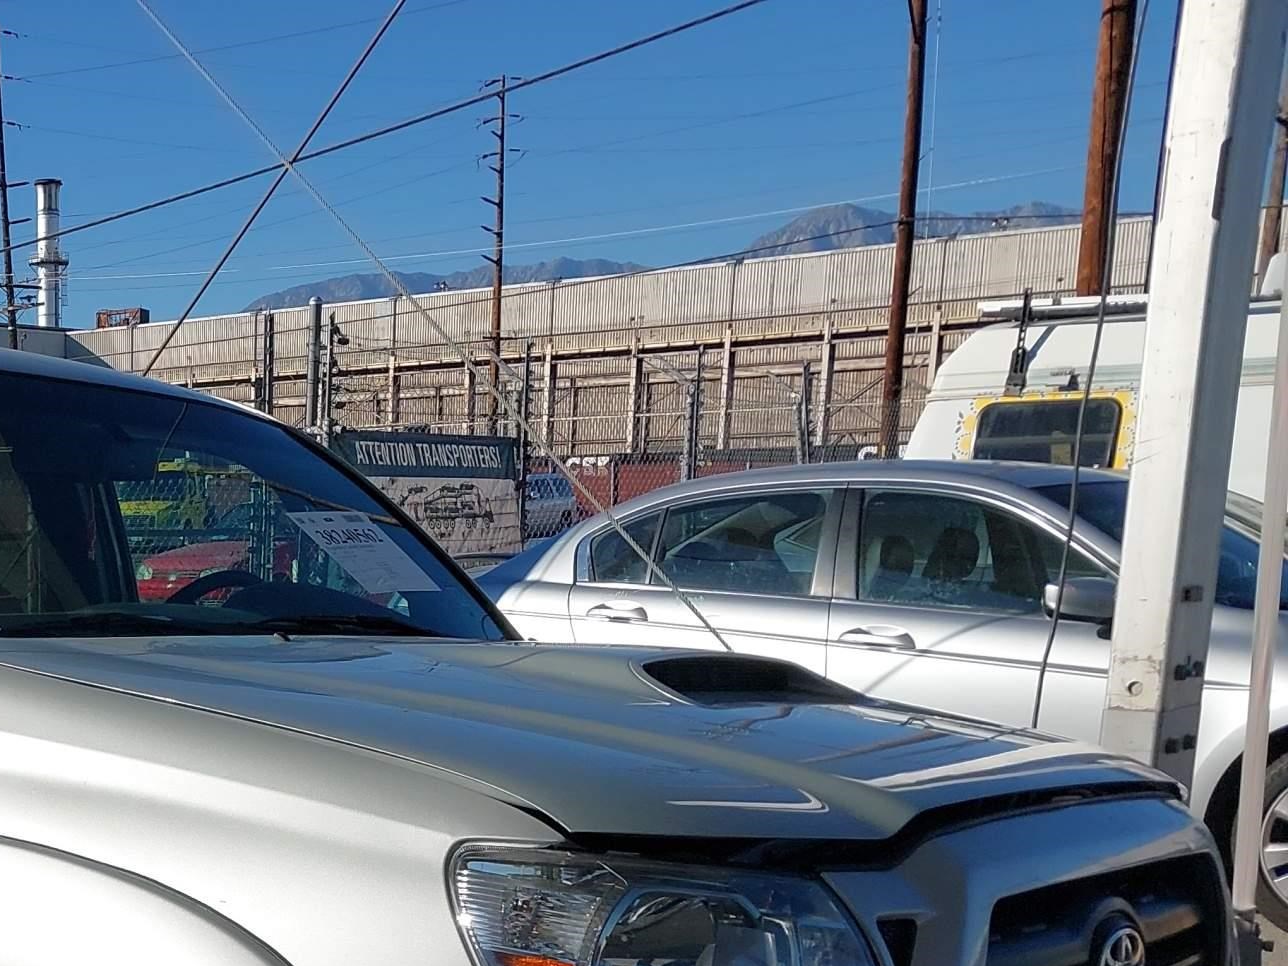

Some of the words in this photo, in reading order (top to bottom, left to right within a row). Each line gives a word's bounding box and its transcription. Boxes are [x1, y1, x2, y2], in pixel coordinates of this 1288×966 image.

[355, 440, 417, 466] ATTENTION
[415, 442, 502, 468] TRANSPORTERS!
[315, 528, 384, 545] 38240562
